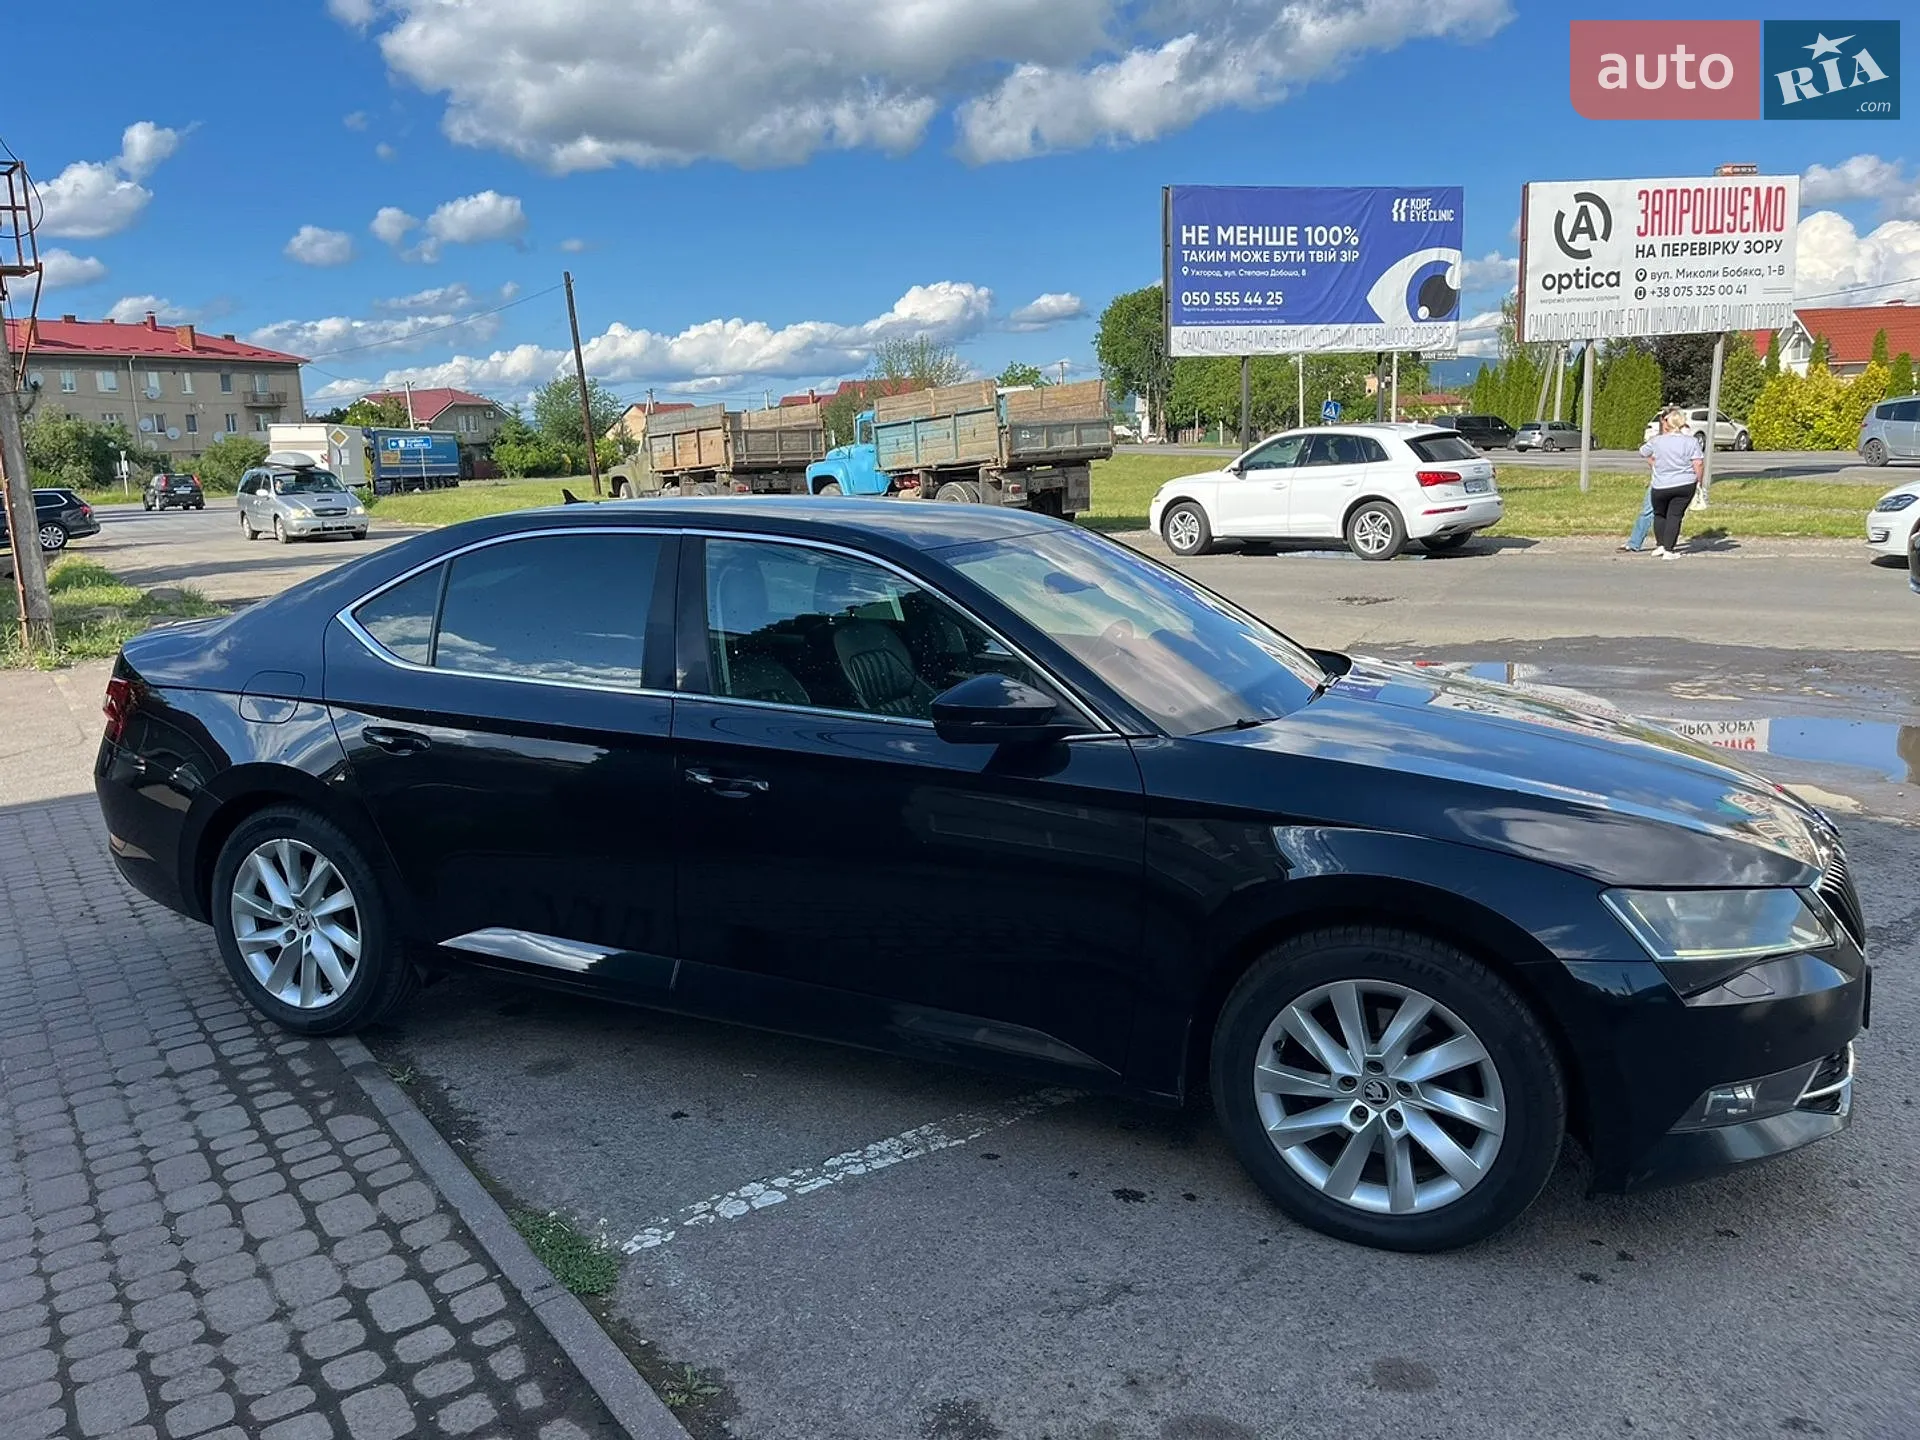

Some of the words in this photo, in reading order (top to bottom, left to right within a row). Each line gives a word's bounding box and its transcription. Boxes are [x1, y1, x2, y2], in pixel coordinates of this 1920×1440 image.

[1410, 210, 1427, 221] EYE
[1428, 209, 1454, 221] CLINIC
[1636, 186, 1786, 237] ЗАПРОШУЄМО
[1181, 225, 1209, 246] НЕ
[1217, 225, 1298, 246] МЕНШЕ
[1304, 226, 1359, 246] 100%
[1182, 250, 1227, 262] ТАКИМ
[1230, 250, 1270, 262] МОЖЕ
[1273, 250, 1305, 262] БУТИ
[1308, 248, 1336, 262] ТВІЙ
[1339, 250, 1360, 262] ЗІР
[1635, 244, 1656, 259] НА
[1661, 240, 1739, 258] ПЕРЕВІРКУ
[1744, 239, 1783, 254] ЗОРУ
[1191, 268, 1223, 277] Ужгород,
[1238, 268, 1269, 277] Степана
[1541, 265, 1621, 294] optica
[1650, 272, 1673, 282] вул.
[1676, 268, 1719, 280] Миколи
[1650, 286, 1671, 298] +38
[1673, 285, 1694, 297] 075
[1696, 285, 1716, 296] 325
[1718, 285, 1734, 296] 00
[1736, 284, 1748, 295] 41
[1181, 291, 1210, 306] 050
[1214, 291, 1240, 306] 555
[1243, 291, 1262, 306] 44
[1266, 291, 1283, 306] 25
